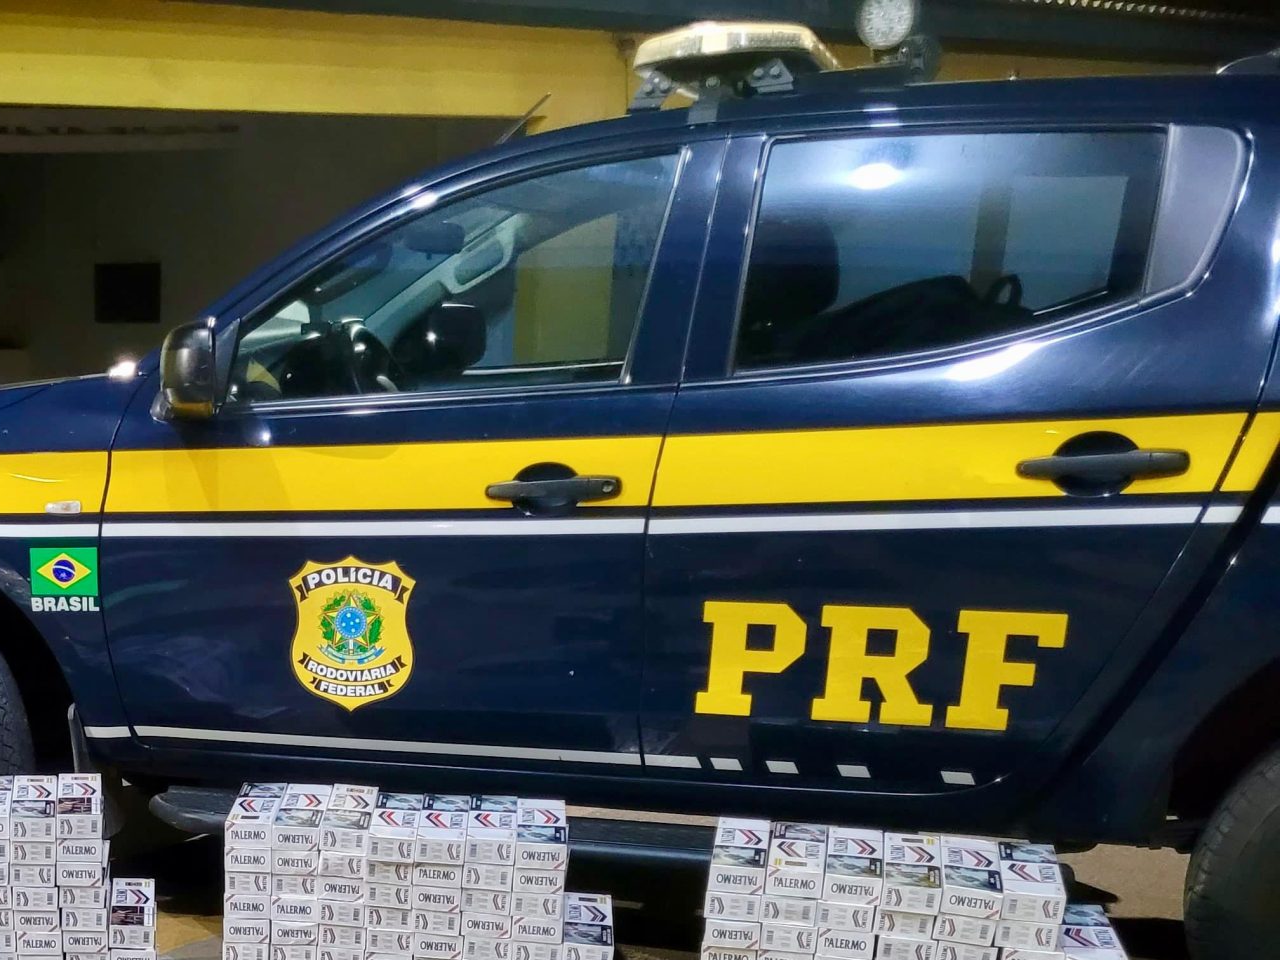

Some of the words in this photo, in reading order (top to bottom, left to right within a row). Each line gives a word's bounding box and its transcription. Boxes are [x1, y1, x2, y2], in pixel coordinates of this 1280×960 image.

[307, 567, 393, 590] POLÍCIA
[31, 597, 100, 612] BRASIL
[695, 601, 1069, 731] PRF
[319, 681, 384, 696] FEDERAL
[231, 830, 266, 840] PALERMO
[231, 855, 265, 865] PALERMO
[521, 851, 560, 862] PALERMO
[520, 875, 558, 886] PALERMO
[716, 873, 758, 886] PALERMO
[831, 883, 874, 896] PALERMO
[418, 893, 455, 905] PALERMO
[949, 895, 995, 910] PALERMO
[277, 904, 312, 915] PALERMO
[229, 926, 263, 936] PALERMO
[518, 924, 556, 936] PALERMO
[23, 939, 56, 948] PALERMO
[824, 937, 867, 951] PALERMO
